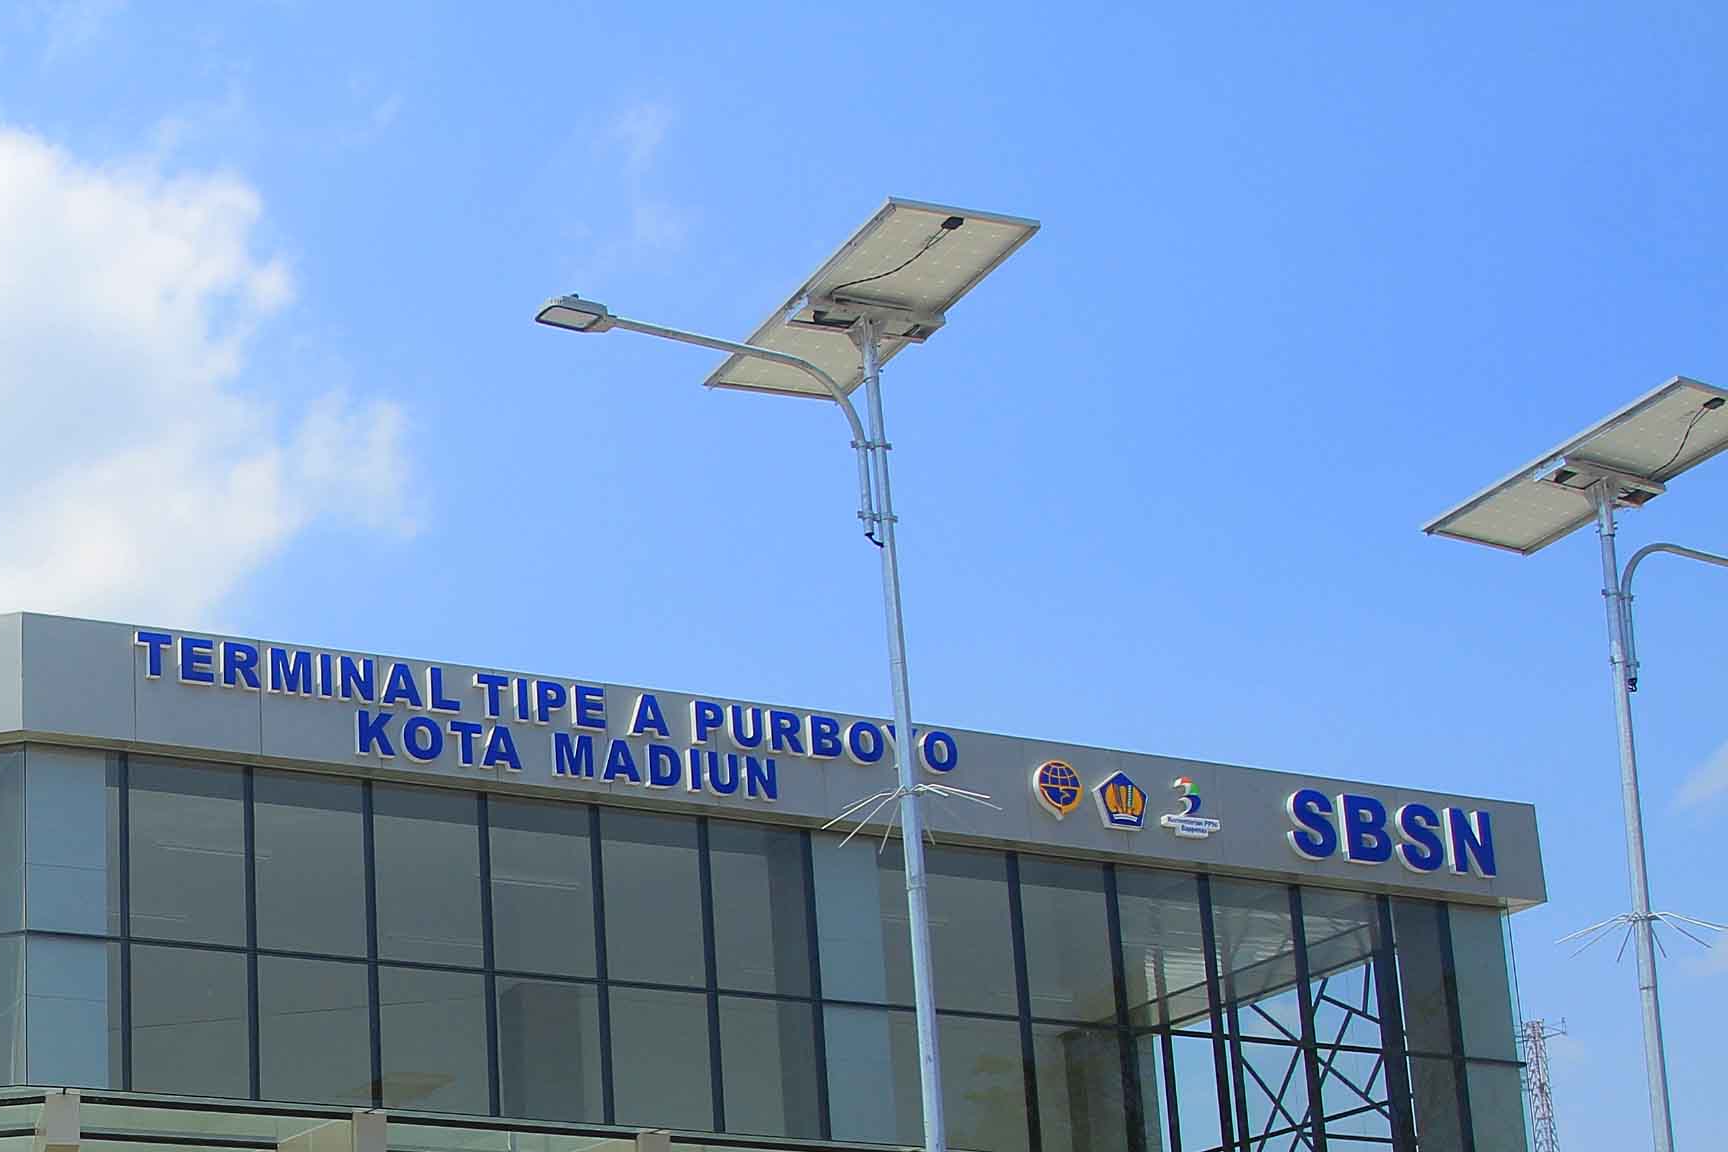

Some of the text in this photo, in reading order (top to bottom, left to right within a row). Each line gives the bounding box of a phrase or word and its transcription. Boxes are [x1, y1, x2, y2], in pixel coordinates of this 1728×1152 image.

[135, 631, 461, 714] TERMINAL
[473, 672, 606, 730] TIPE
[627, 693, 670, 738] A
[355, 709, 778, 800] KOTA MADIUN
[1286, 789, 1496, 878] SBSN
